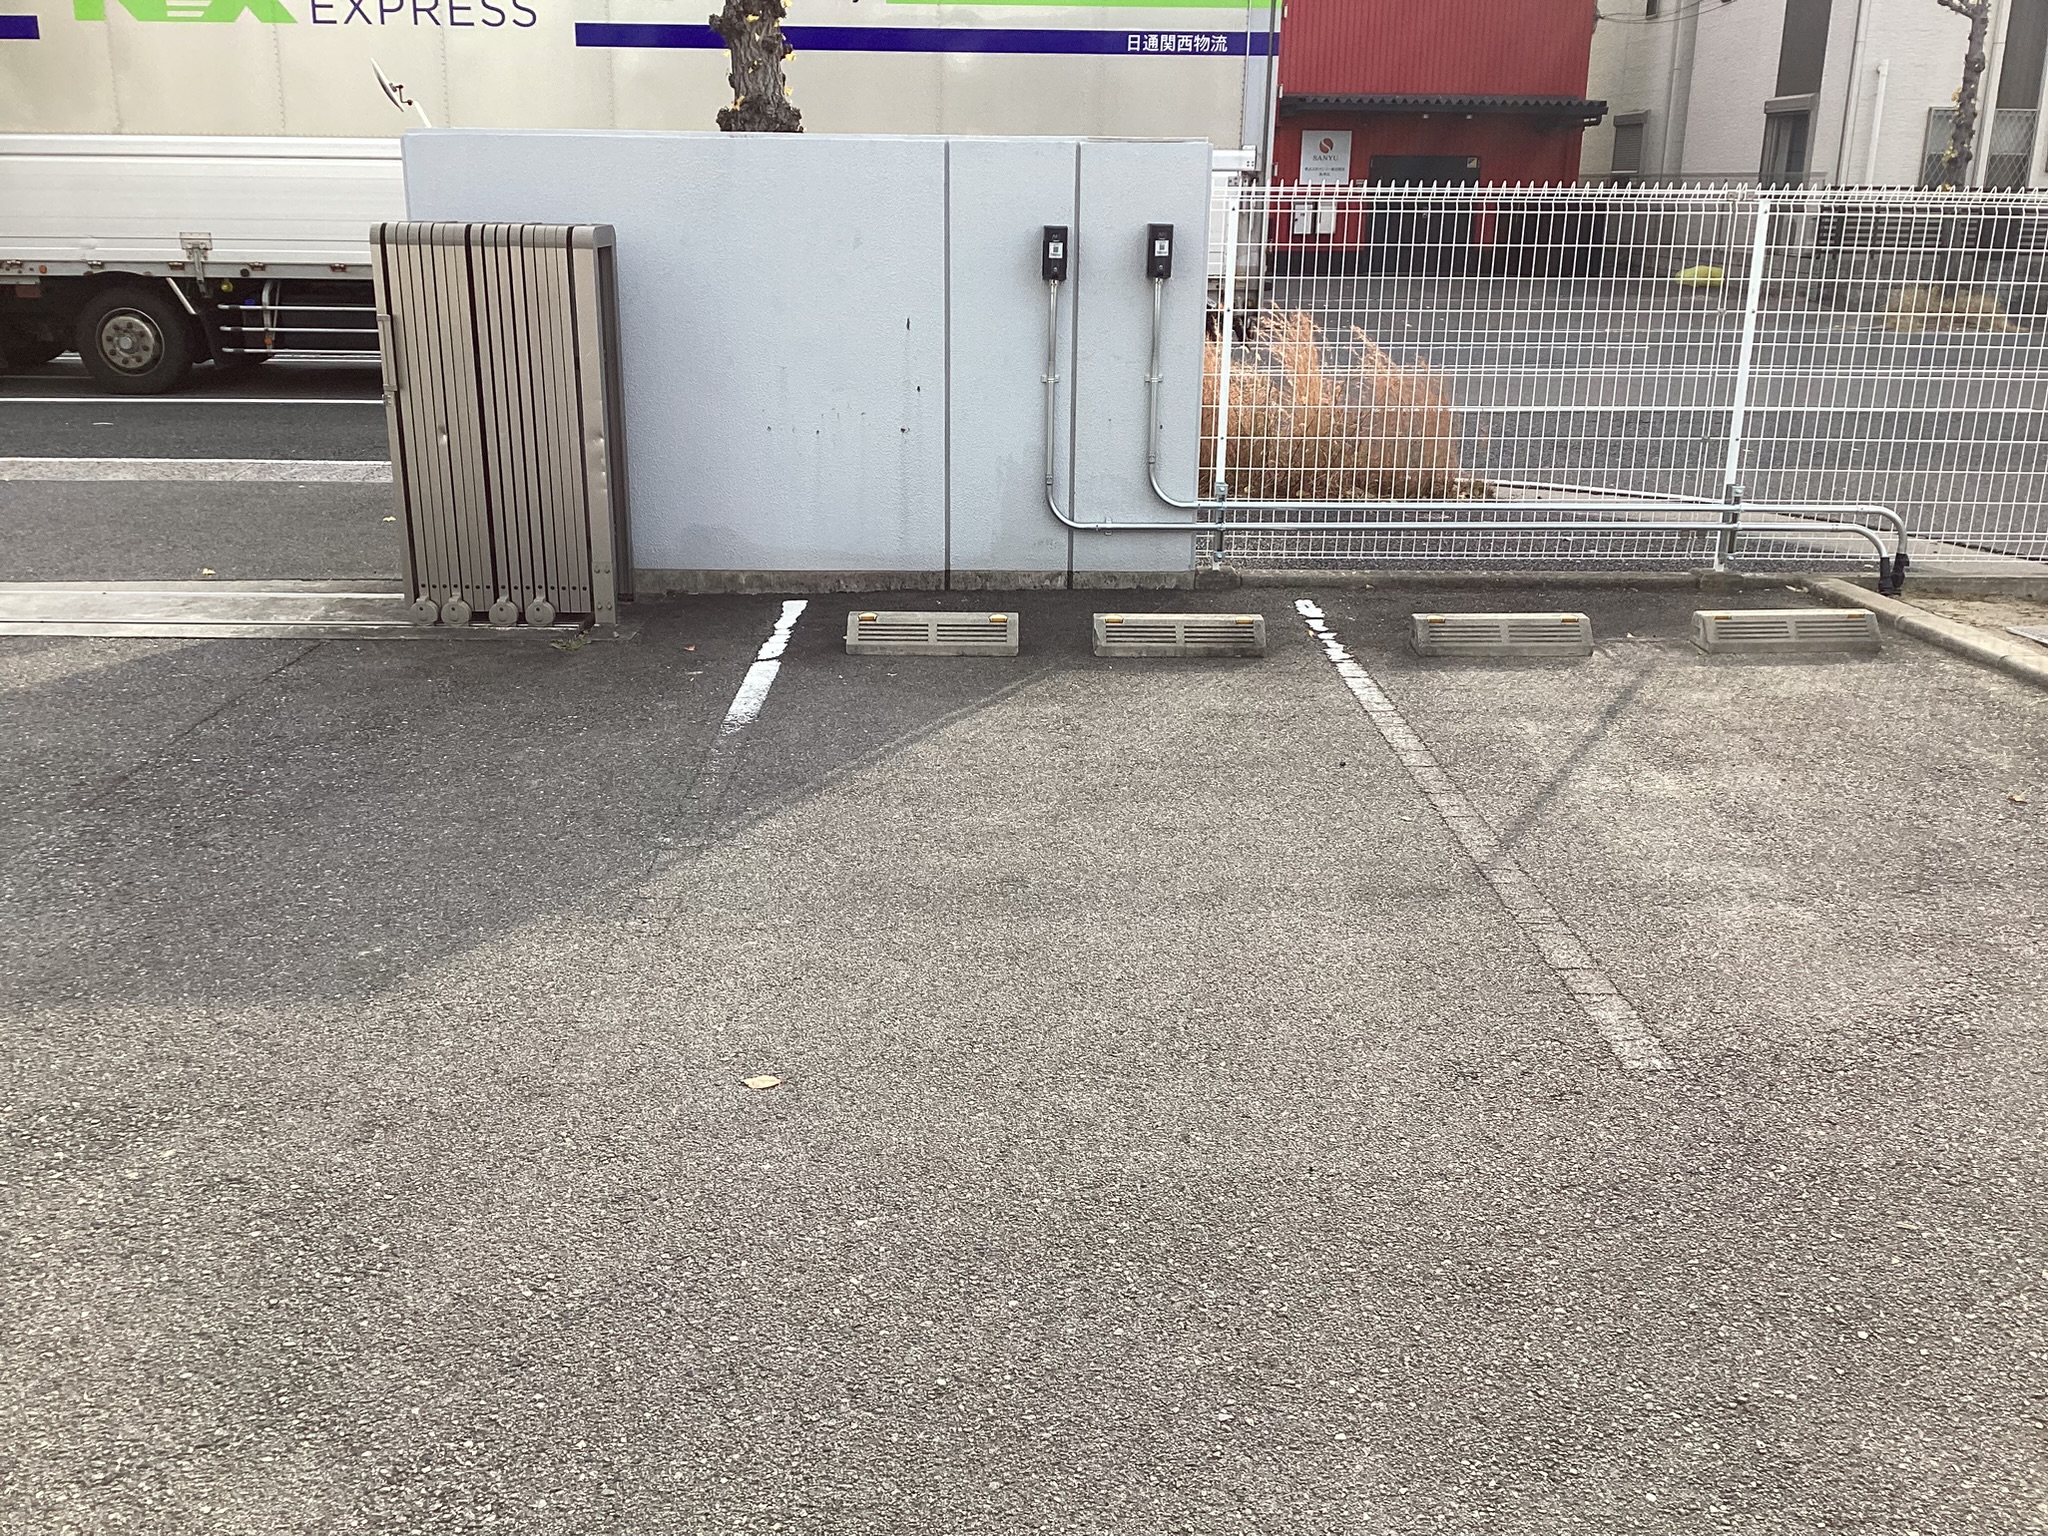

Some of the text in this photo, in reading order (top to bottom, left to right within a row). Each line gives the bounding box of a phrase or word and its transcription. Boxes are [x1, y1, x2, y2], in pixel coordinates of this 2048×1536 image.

[311, 0, 537, 27] EXPRESS
[1127, 34, 1228, 52] 日通関西物流
